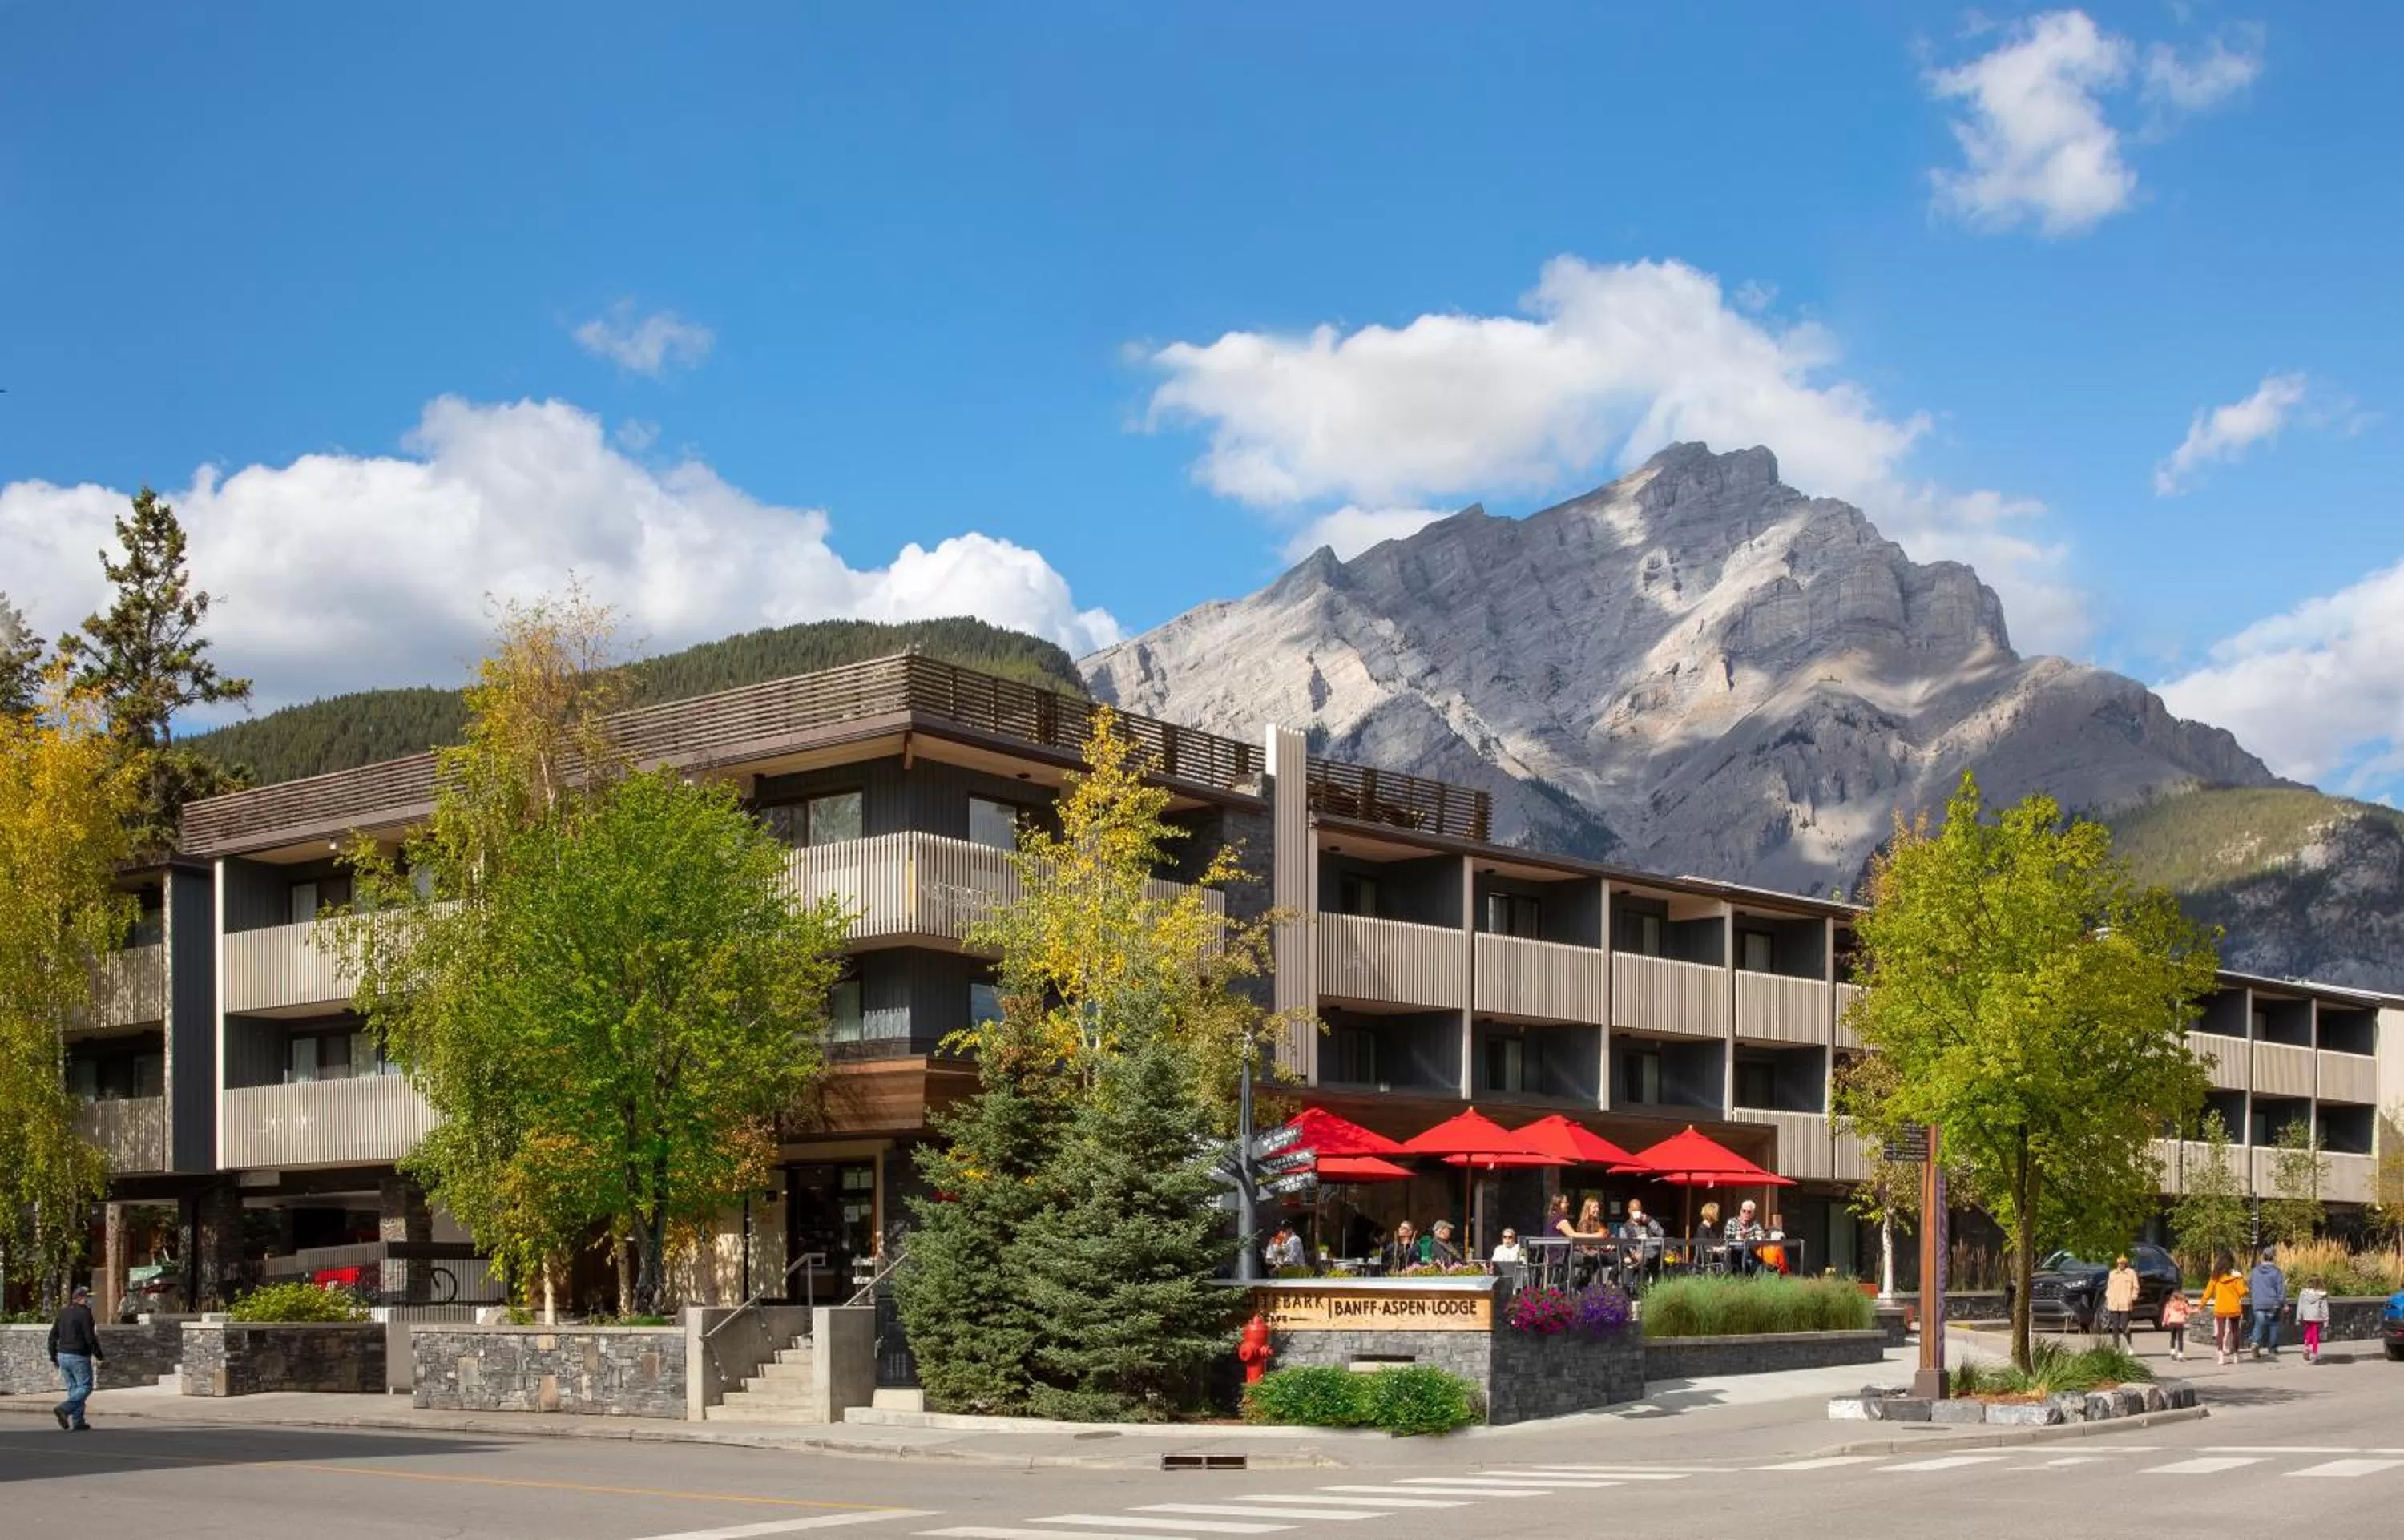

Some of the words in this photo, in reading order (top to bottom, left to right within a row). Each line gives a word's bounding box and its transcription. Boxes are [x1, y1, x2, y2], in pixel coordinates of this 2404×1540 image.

[1334, 1300, 1377, 1316] BANFF
[1381, 1300, 1426, 1316] ASPEN
[1432, 1300, 1477, 1315] LODGE
